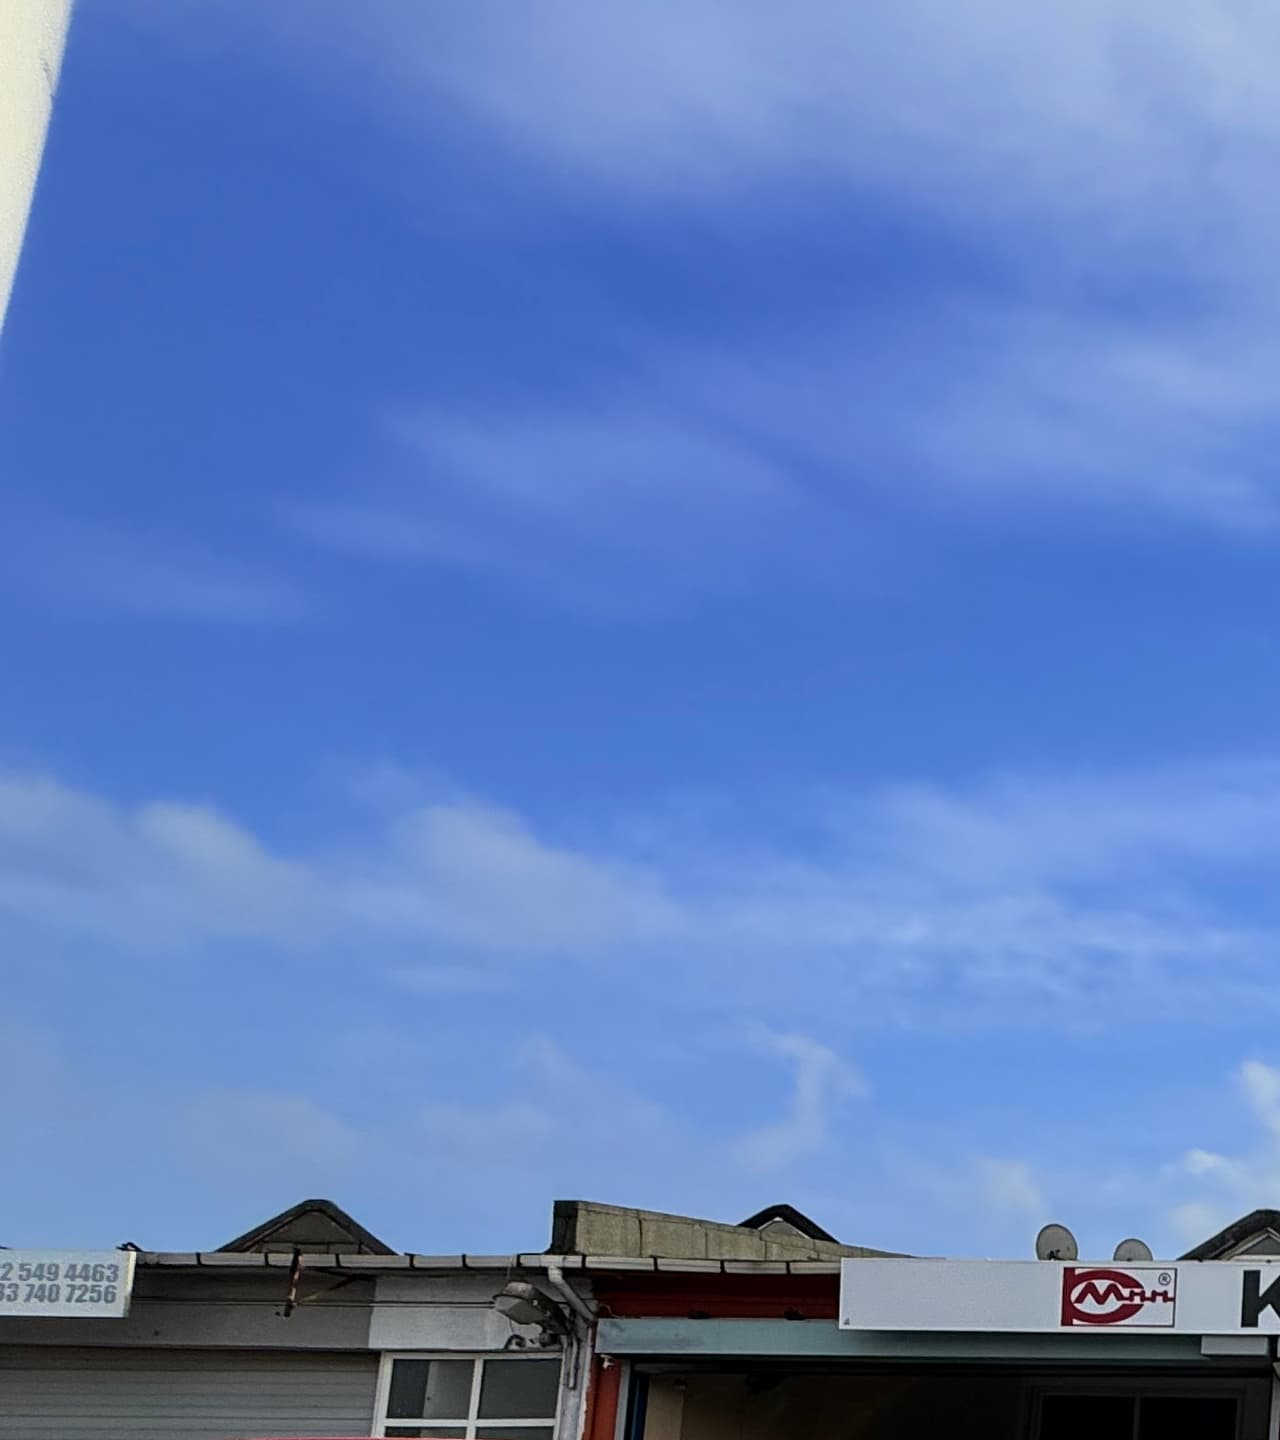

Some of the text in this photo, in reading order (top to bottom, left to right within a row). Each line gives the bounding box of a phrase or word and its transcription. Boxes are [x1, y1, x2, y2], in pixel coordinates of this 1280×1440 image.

[18, 1263, 59, 1281] 549
[64, 1263, 119, 1282] 4463
[24, 1284, 60, 1303] 740
[65, 1284, 117, 1303] 7256
